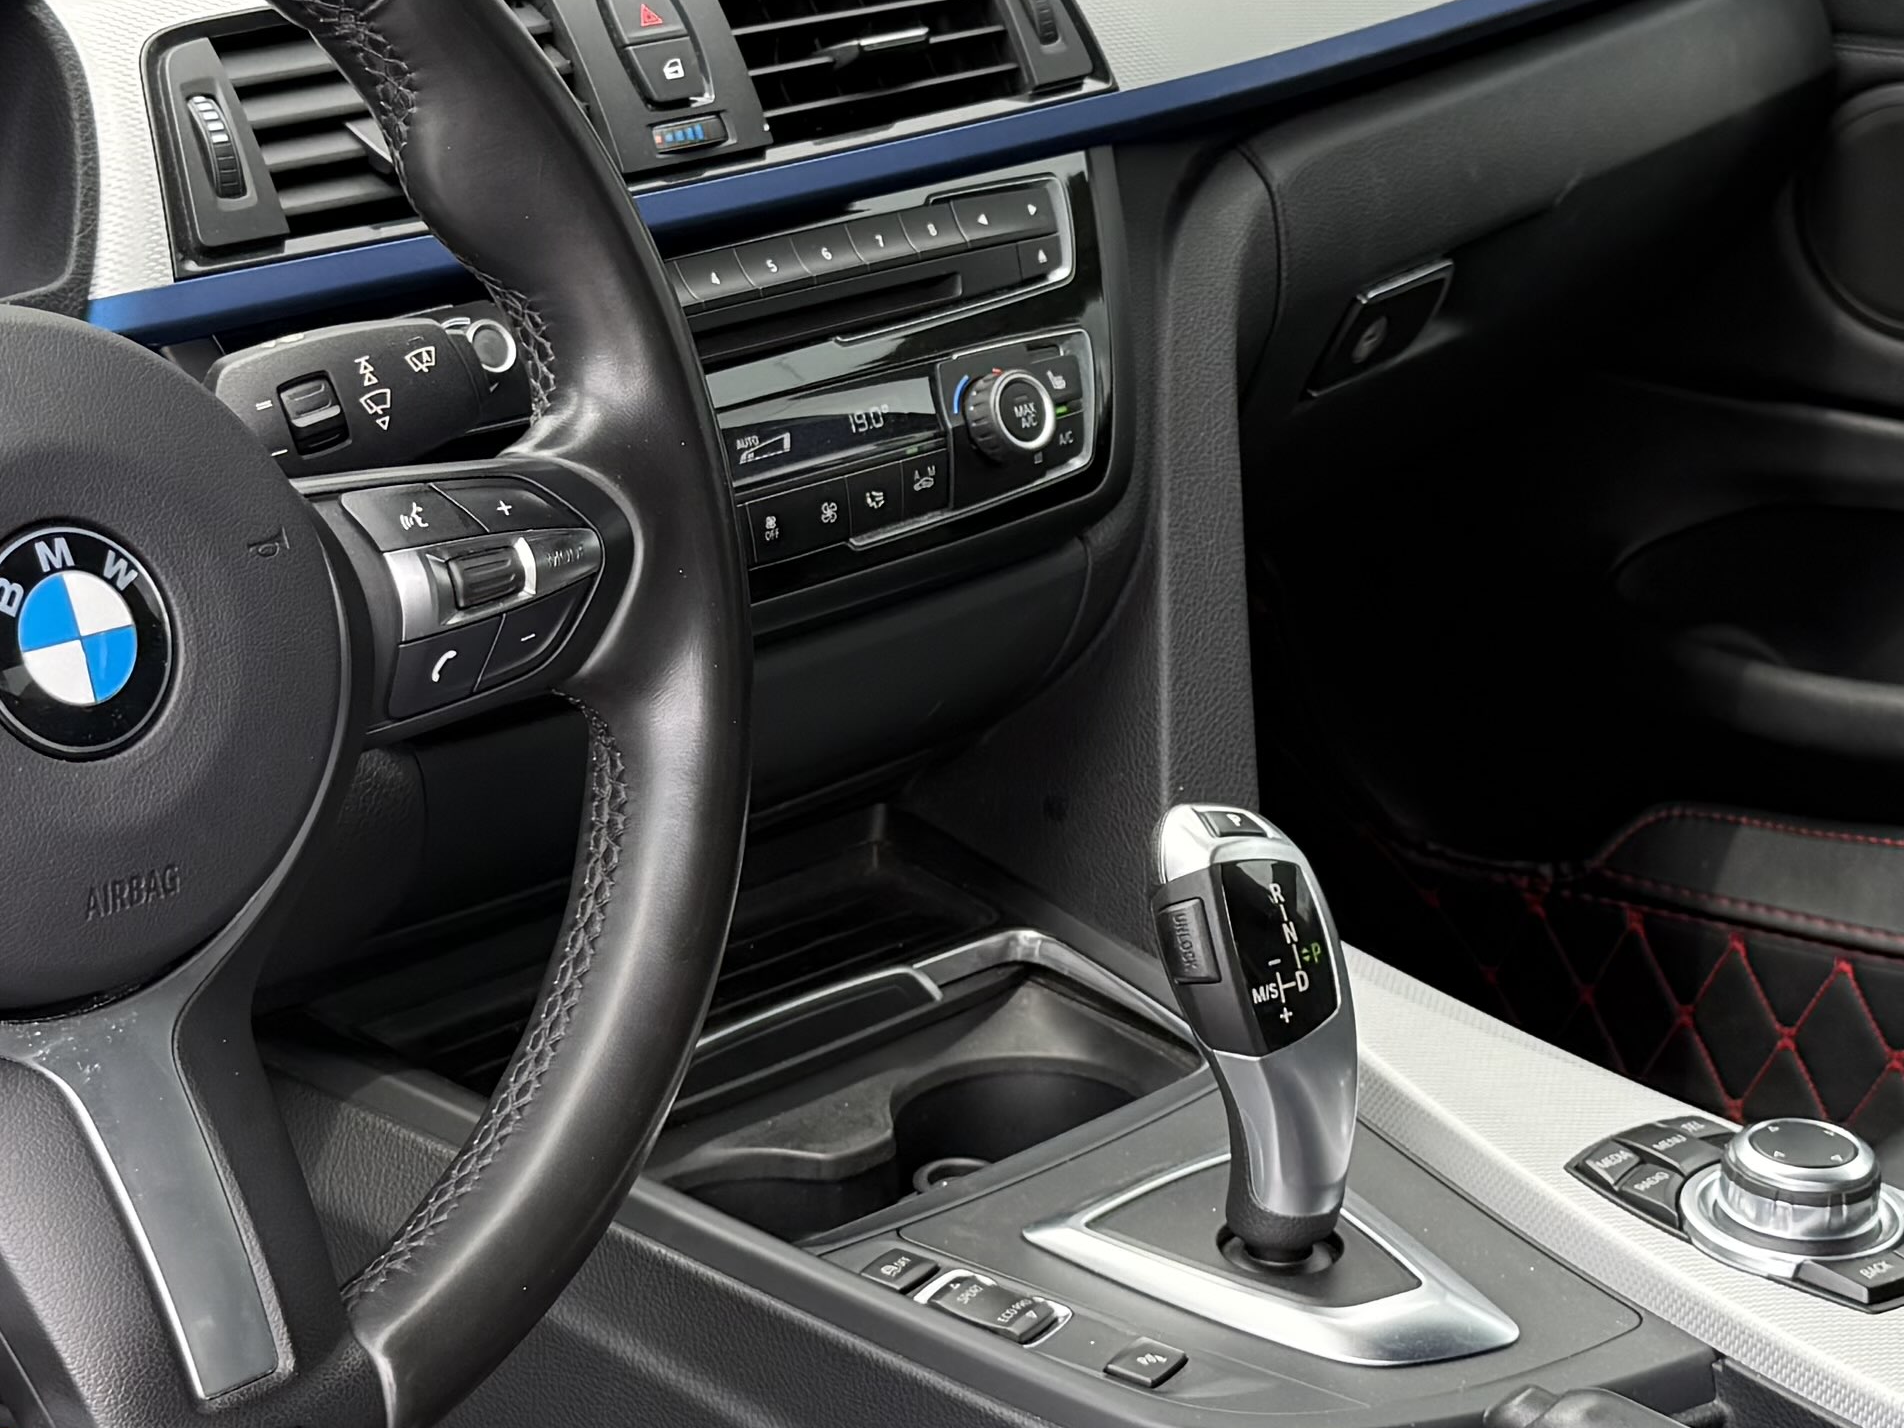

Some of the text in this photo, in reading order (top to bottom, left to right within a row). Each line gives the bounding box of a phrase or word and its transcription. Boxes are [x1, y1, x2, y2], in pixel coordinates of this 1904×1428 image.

[927, 223, 938, 237] 8
[875, 234, 885, 248] 7
[821, 247, 833, 261] 6
[766, 259, 778, 273] 5
[710, 272, 721, 285] 4
[1013, 401, 1037, 418] MAX
[1021, 416, 1038, 429] A/C
[736, 435, 760, 450] AUTO
[1059, 430, 1074, 446] A/C
[764, 528, 780, 541] OFF
[85, 864, 181, 922] AIRBAG
[1269, 883, 1285, 903] R
[1282, 921, 1298, 944] N
[1172, 912, 1198, 972] UNLOCK
[1310, 942, 1322, 963] P
[1295, 970, 1309, 992] D
[1252, 983, 1279, 1004] M/S
[1652, 1134, 1687, 1151] MENU
[1596, 1150, 1634, 1169] MEDIA
[1633, 1171, 1670, 1191] RADIO
[1859, 1261, 1895, 1279] BACK
[956, 1284, 983, 1305] SPORT
